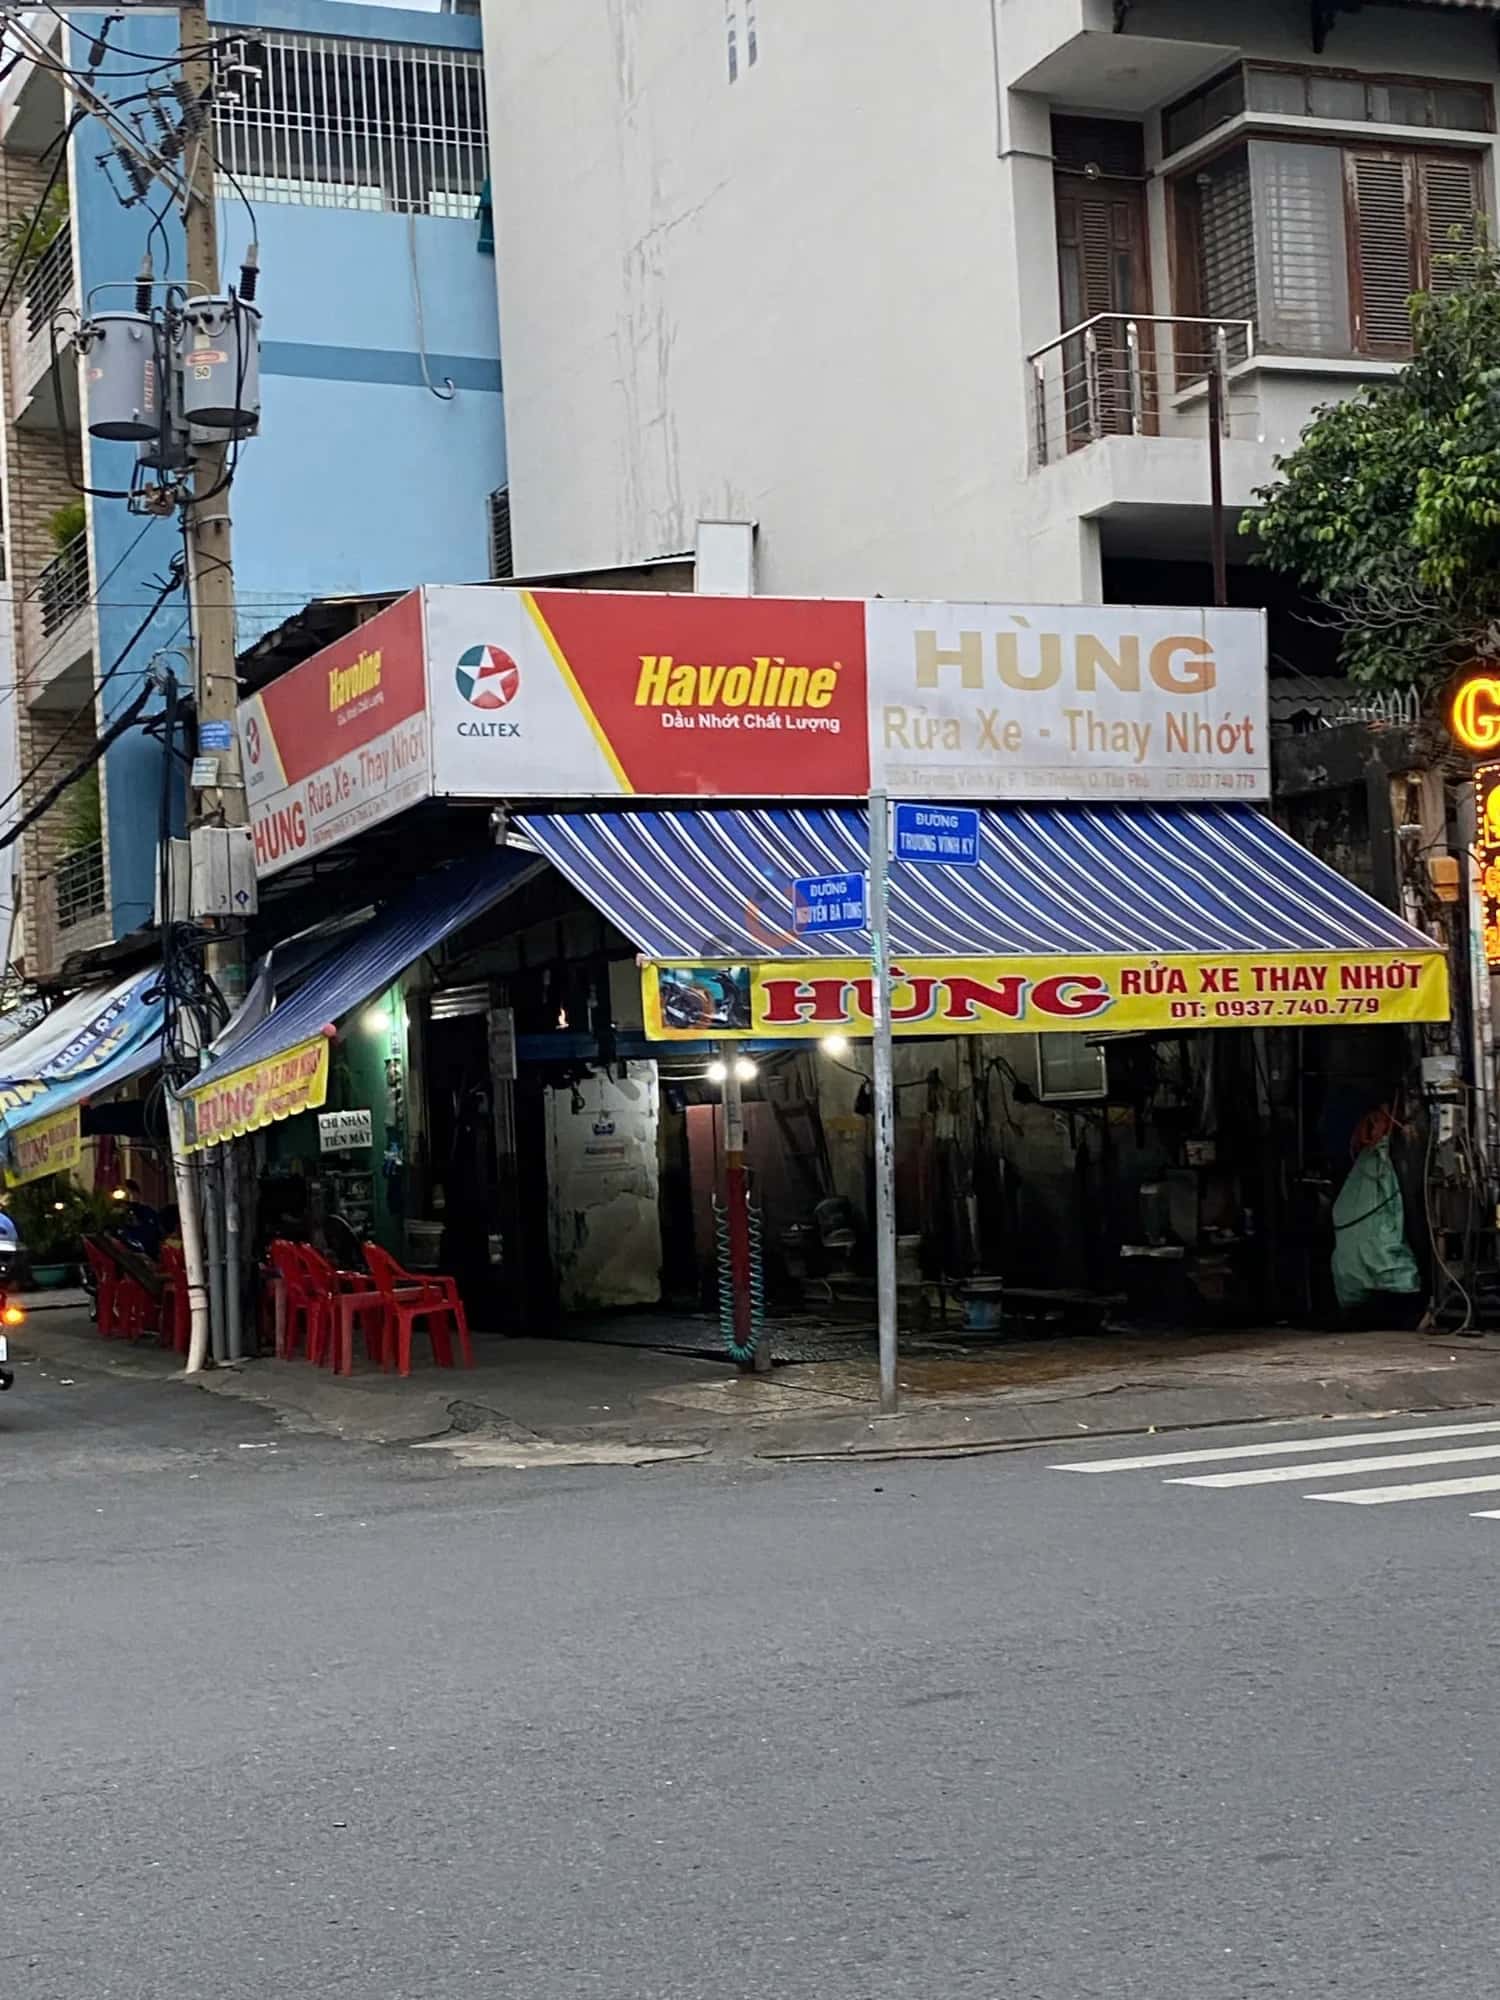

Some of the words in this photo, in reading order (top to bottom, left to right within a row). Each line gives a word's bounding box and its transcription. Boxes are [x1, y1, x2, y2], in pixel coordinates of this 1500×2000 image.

[914, 615, 1216, 694] HÙNG
[328, 650, 381, 712] Havoline
[634, 656, 837, 708] Havoline
[457, 721, 520, 737] CALTEX
[661, 710, 695, 728] Dầu
[699, 713, 740, 729] Nhớt
[743, 712, 781, 729] Chất
[786, 715, 840, 733] Lượng
[882, 702, 961, 751] Rửa
[976, 708, 1022, 752] Xe
[1061, 709, 1153, 764] Thay
[1165, 712, 1254, 755] Nhớt
[358, 750, 389, 790] Thay
[252, 801, 306, 866] HÙNG
[916, 810, 959, 828] ĐƯỜNG
[810, 880, 848, 897] ĐƯỜNG
[761, 966, 1111, 1022] HÙNG
[1120, 960, 1188, 994] RỬA
[1199, 967, 1240, 993] XE
[1251, 966, 1328, 992] THAY
[1340, 959, 1423, 990] NHỚT
[1170, 1002, 1206, 1018] ĐT:
[1214, 998, 1380, 1017] 0937.740.779
